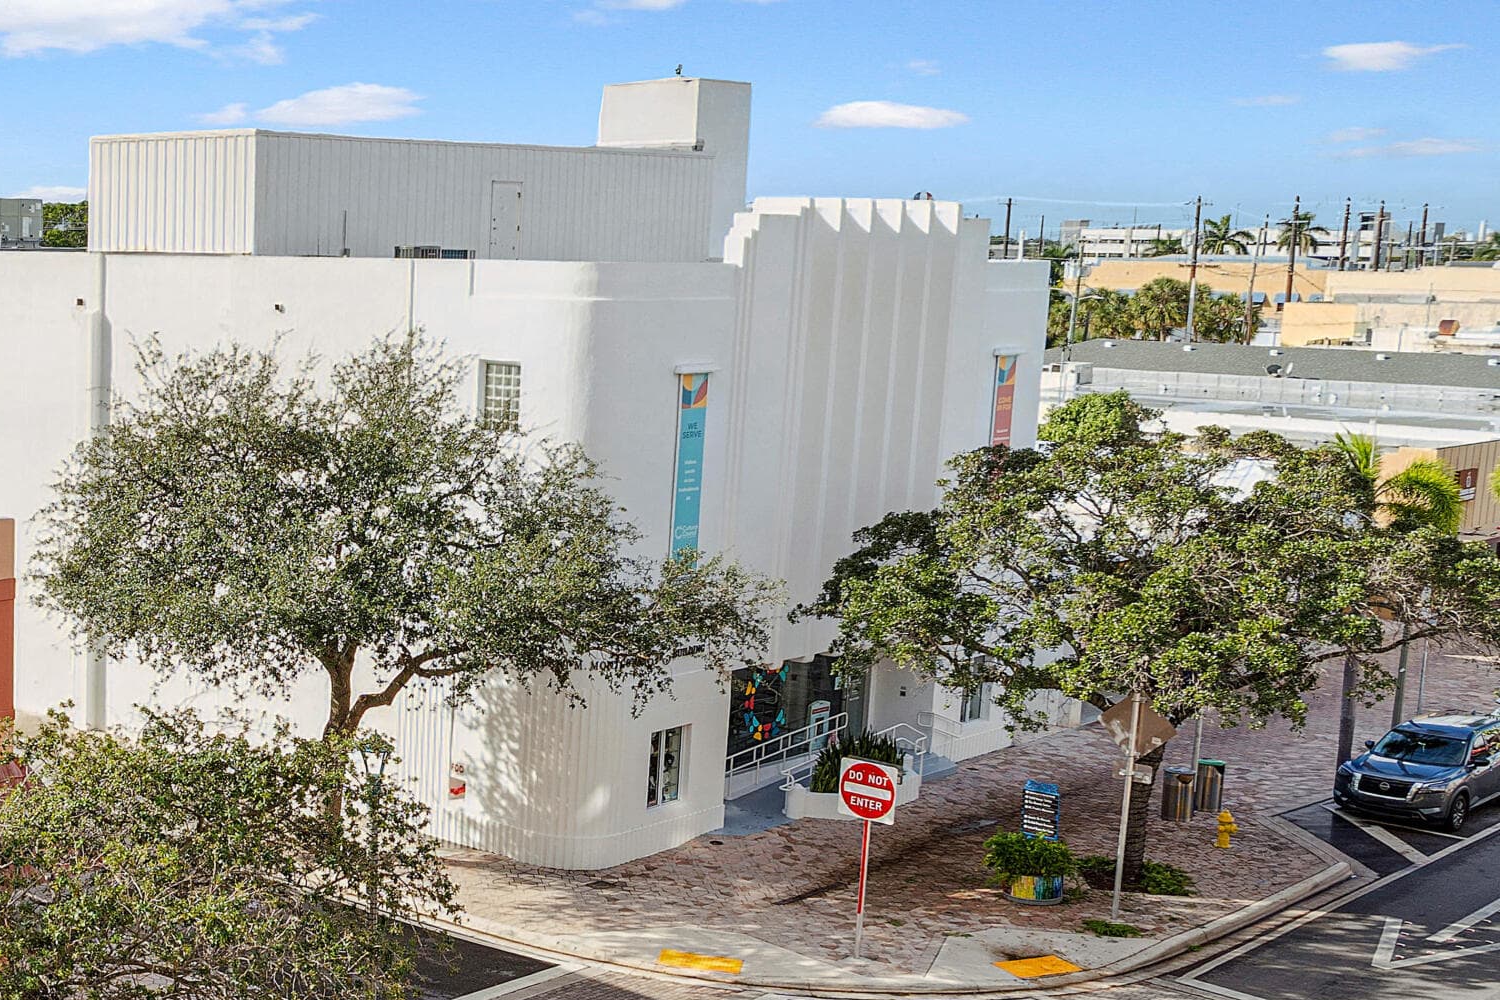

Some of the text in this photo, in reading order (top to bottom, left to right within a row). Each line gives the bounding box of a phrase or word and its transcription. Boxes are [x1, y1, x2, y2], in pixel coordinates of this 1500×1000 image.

[849, 769, 889, 787] DO NOT
[850, 795, 882, 811] ENTER
